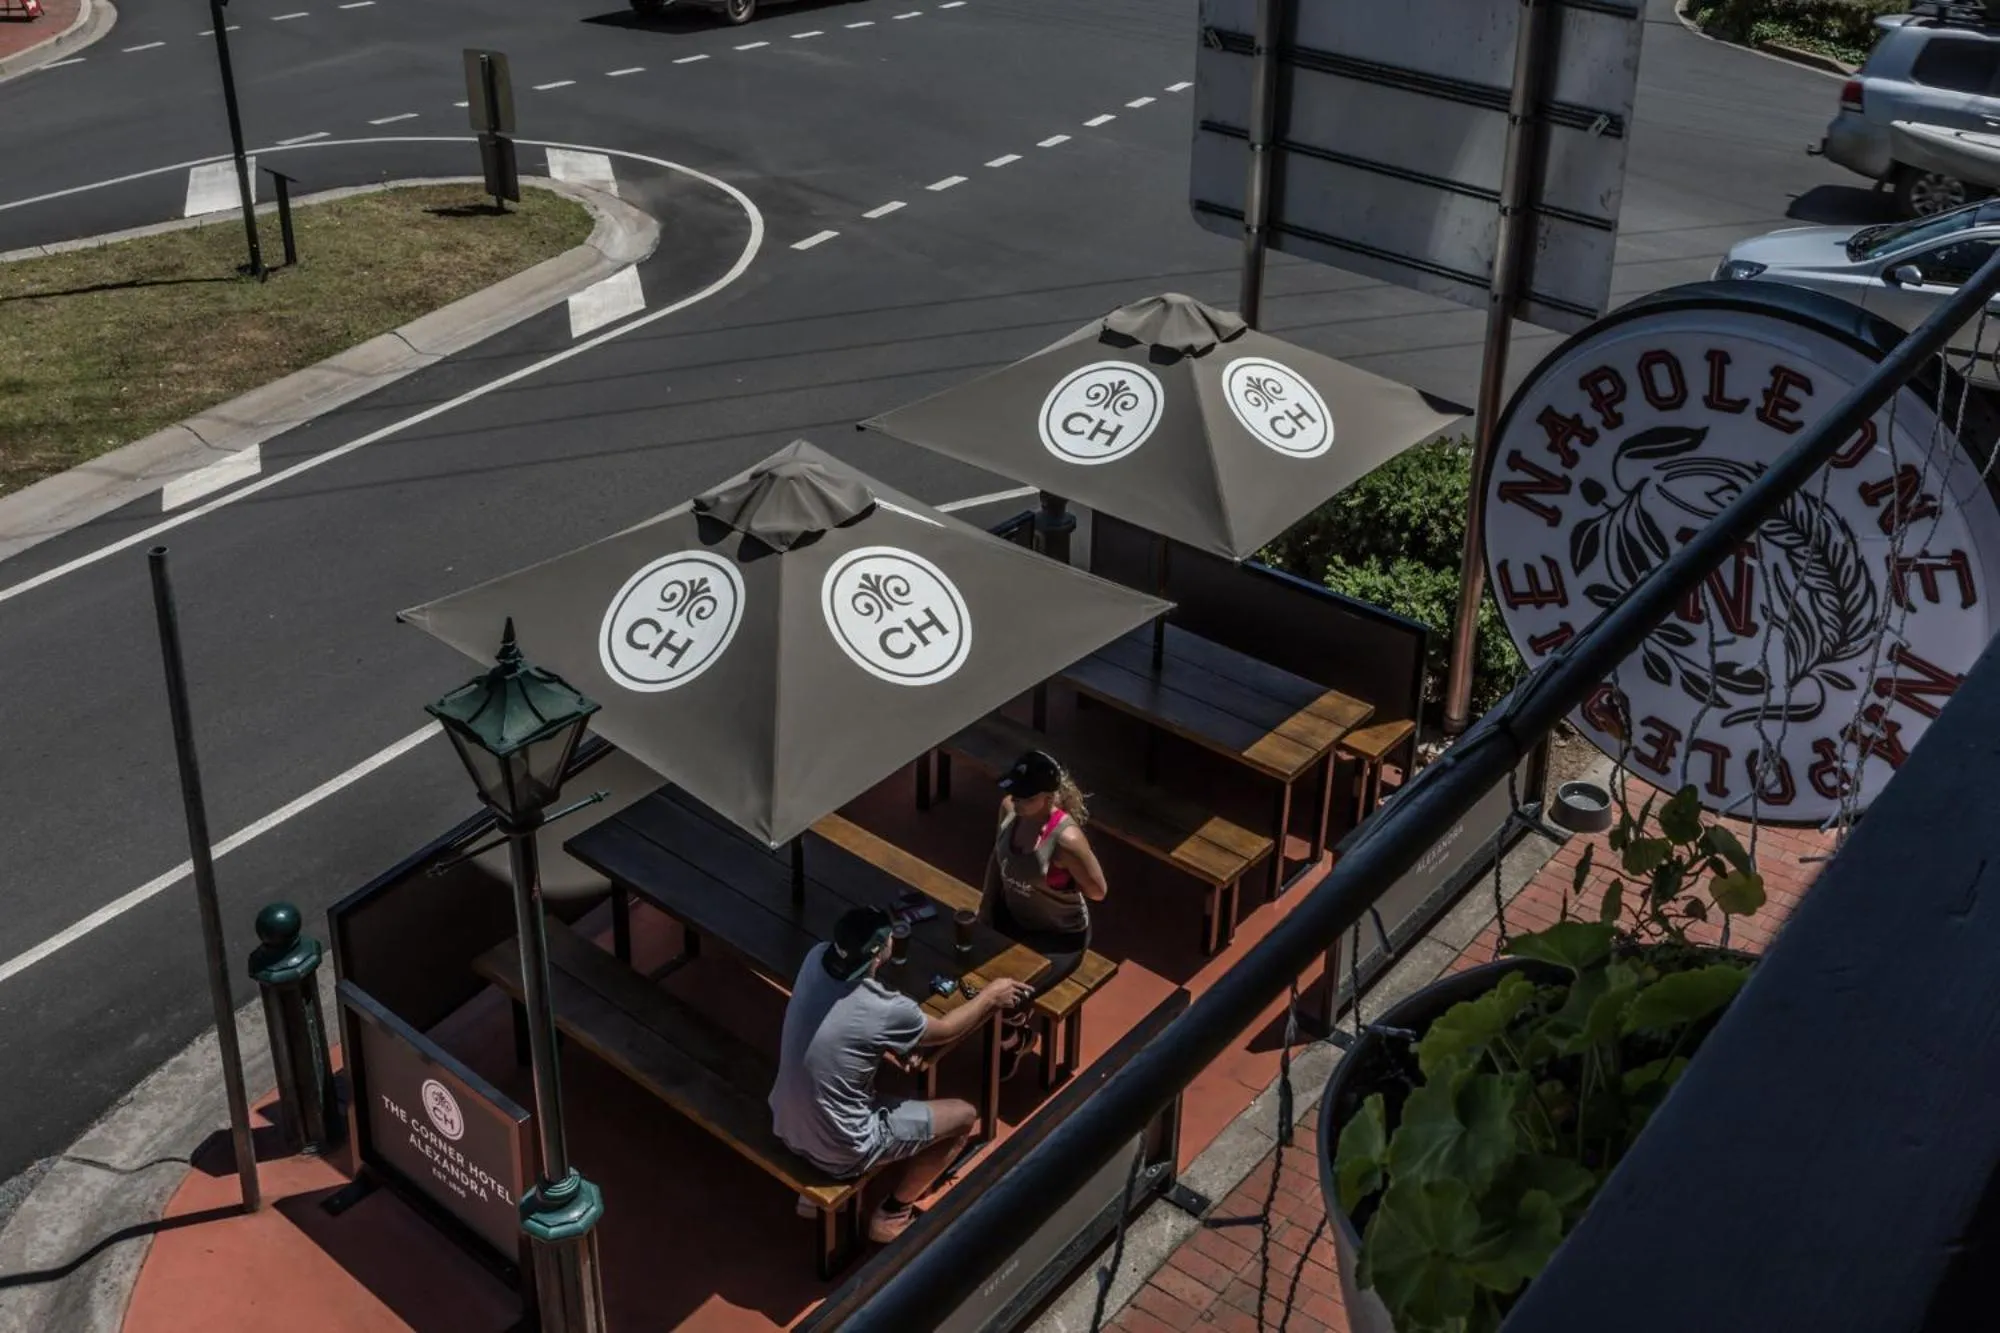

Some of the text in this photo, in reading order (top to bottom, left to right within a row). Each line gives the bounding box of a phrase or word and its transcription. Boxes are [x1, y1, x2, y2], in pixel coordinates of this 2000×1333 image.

[1060, 411, 1125, 447] CH
[1268, 402, 1318, 440] CH
[625, 616, 694, 669] CH
[878, 607, 950, 660] CH
[381, 1094, 408, 1124] THE
[411, 1118, 465, 1167] CORNER
[469, 1162, 515, 1206] HOTEL
[409, 1133, 489, 1203] ALEXANDRA
